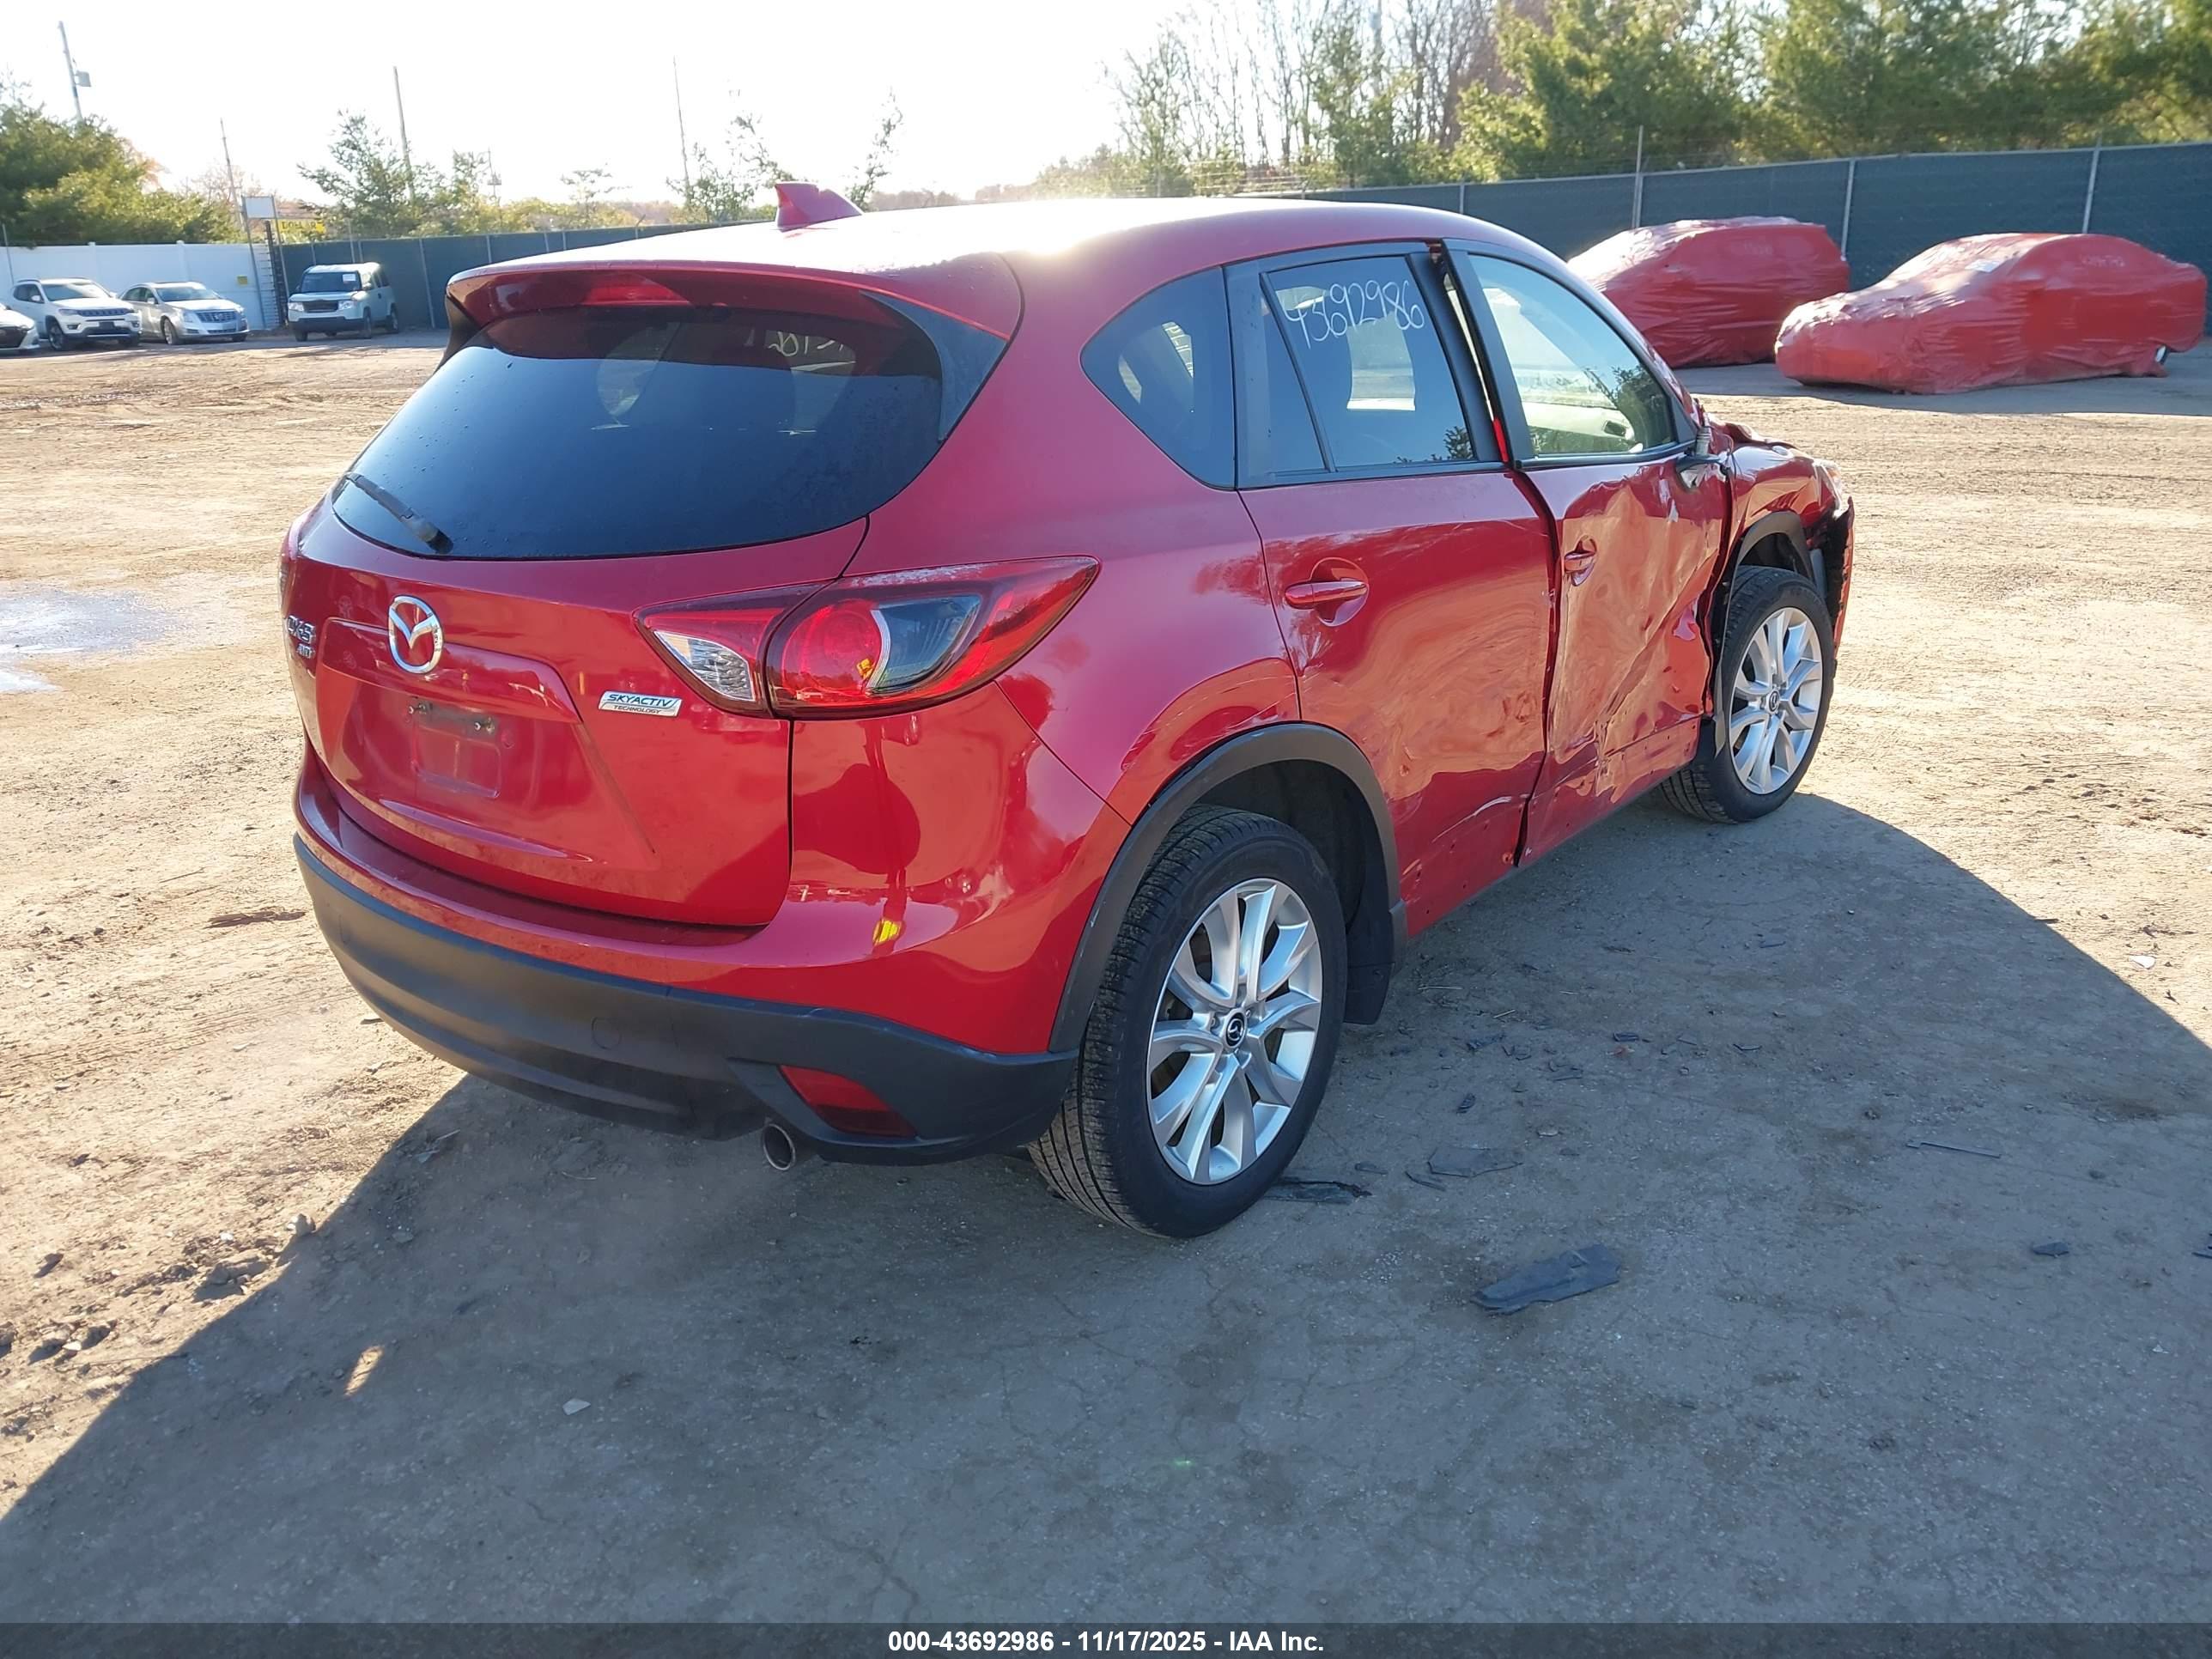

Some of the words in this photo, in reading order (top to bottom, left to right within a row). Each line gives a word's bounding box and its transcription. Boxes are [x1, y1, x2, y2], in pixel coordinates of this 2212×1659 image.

[281, 221, 317, 229] DOLLR
[1282, 279, 1425, 349] 43692986
[607, 694, 672, 708] SKYACTIV
[613, 704, 661, 714] TECHNOLOGY
